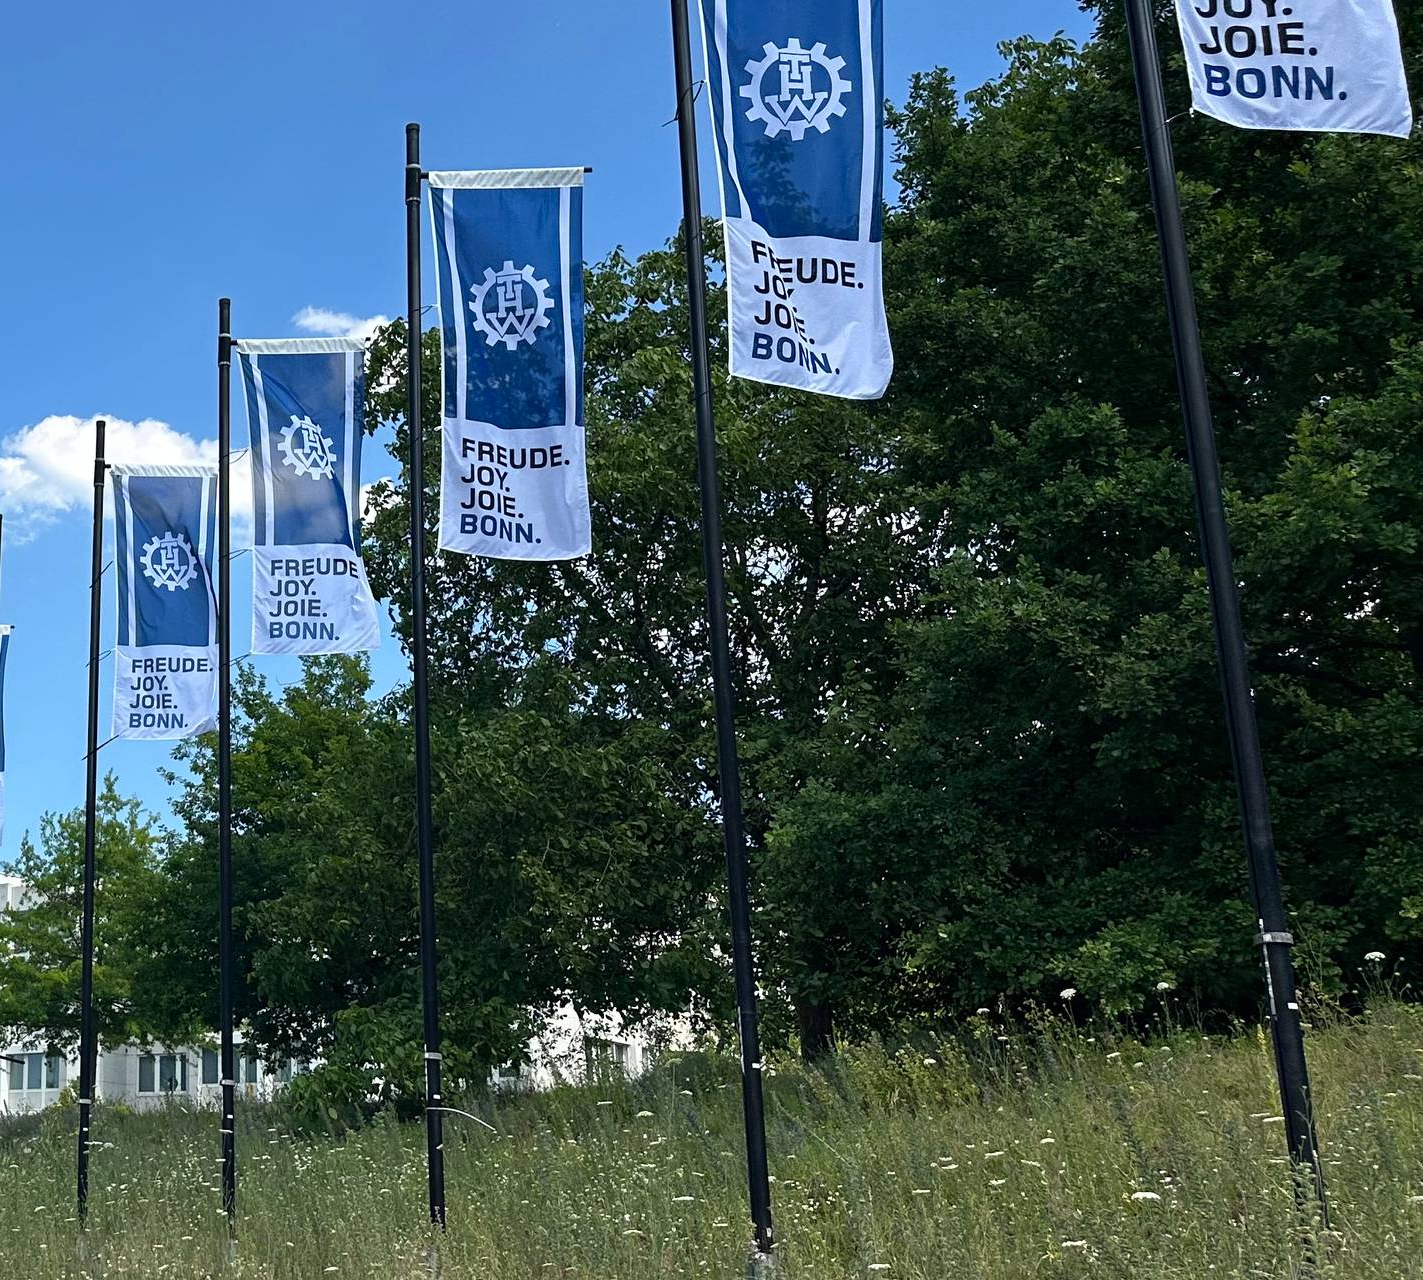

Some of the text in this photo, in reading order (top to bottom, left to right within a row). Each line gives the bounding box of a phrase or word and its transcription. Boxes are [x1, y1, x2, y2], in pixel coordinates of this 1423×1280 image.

[1199, 22, 1318, 58] JOIE.
[1204, 64, 1348, 101] BONN.
[752, 332, 840, 375] BONN.
[462, 438, 571, 469] FREUDE.
[461, 464, 510, 492] JOY.
[460, 488, 525, 519] JOIE.
[460, 513, 542, 544] BONN.
[270, 579, 316, 597] JOY.
[269, 599, 327, 617] JOIE.
[269, 621, 340, 640] BONN.
[132, 657, 213, 674] FREUDE.
[131, 676, 168, 691] JOY.
[130, 694, 177, 710] JOIE.
[129, 713, 188, 729] BONN.
